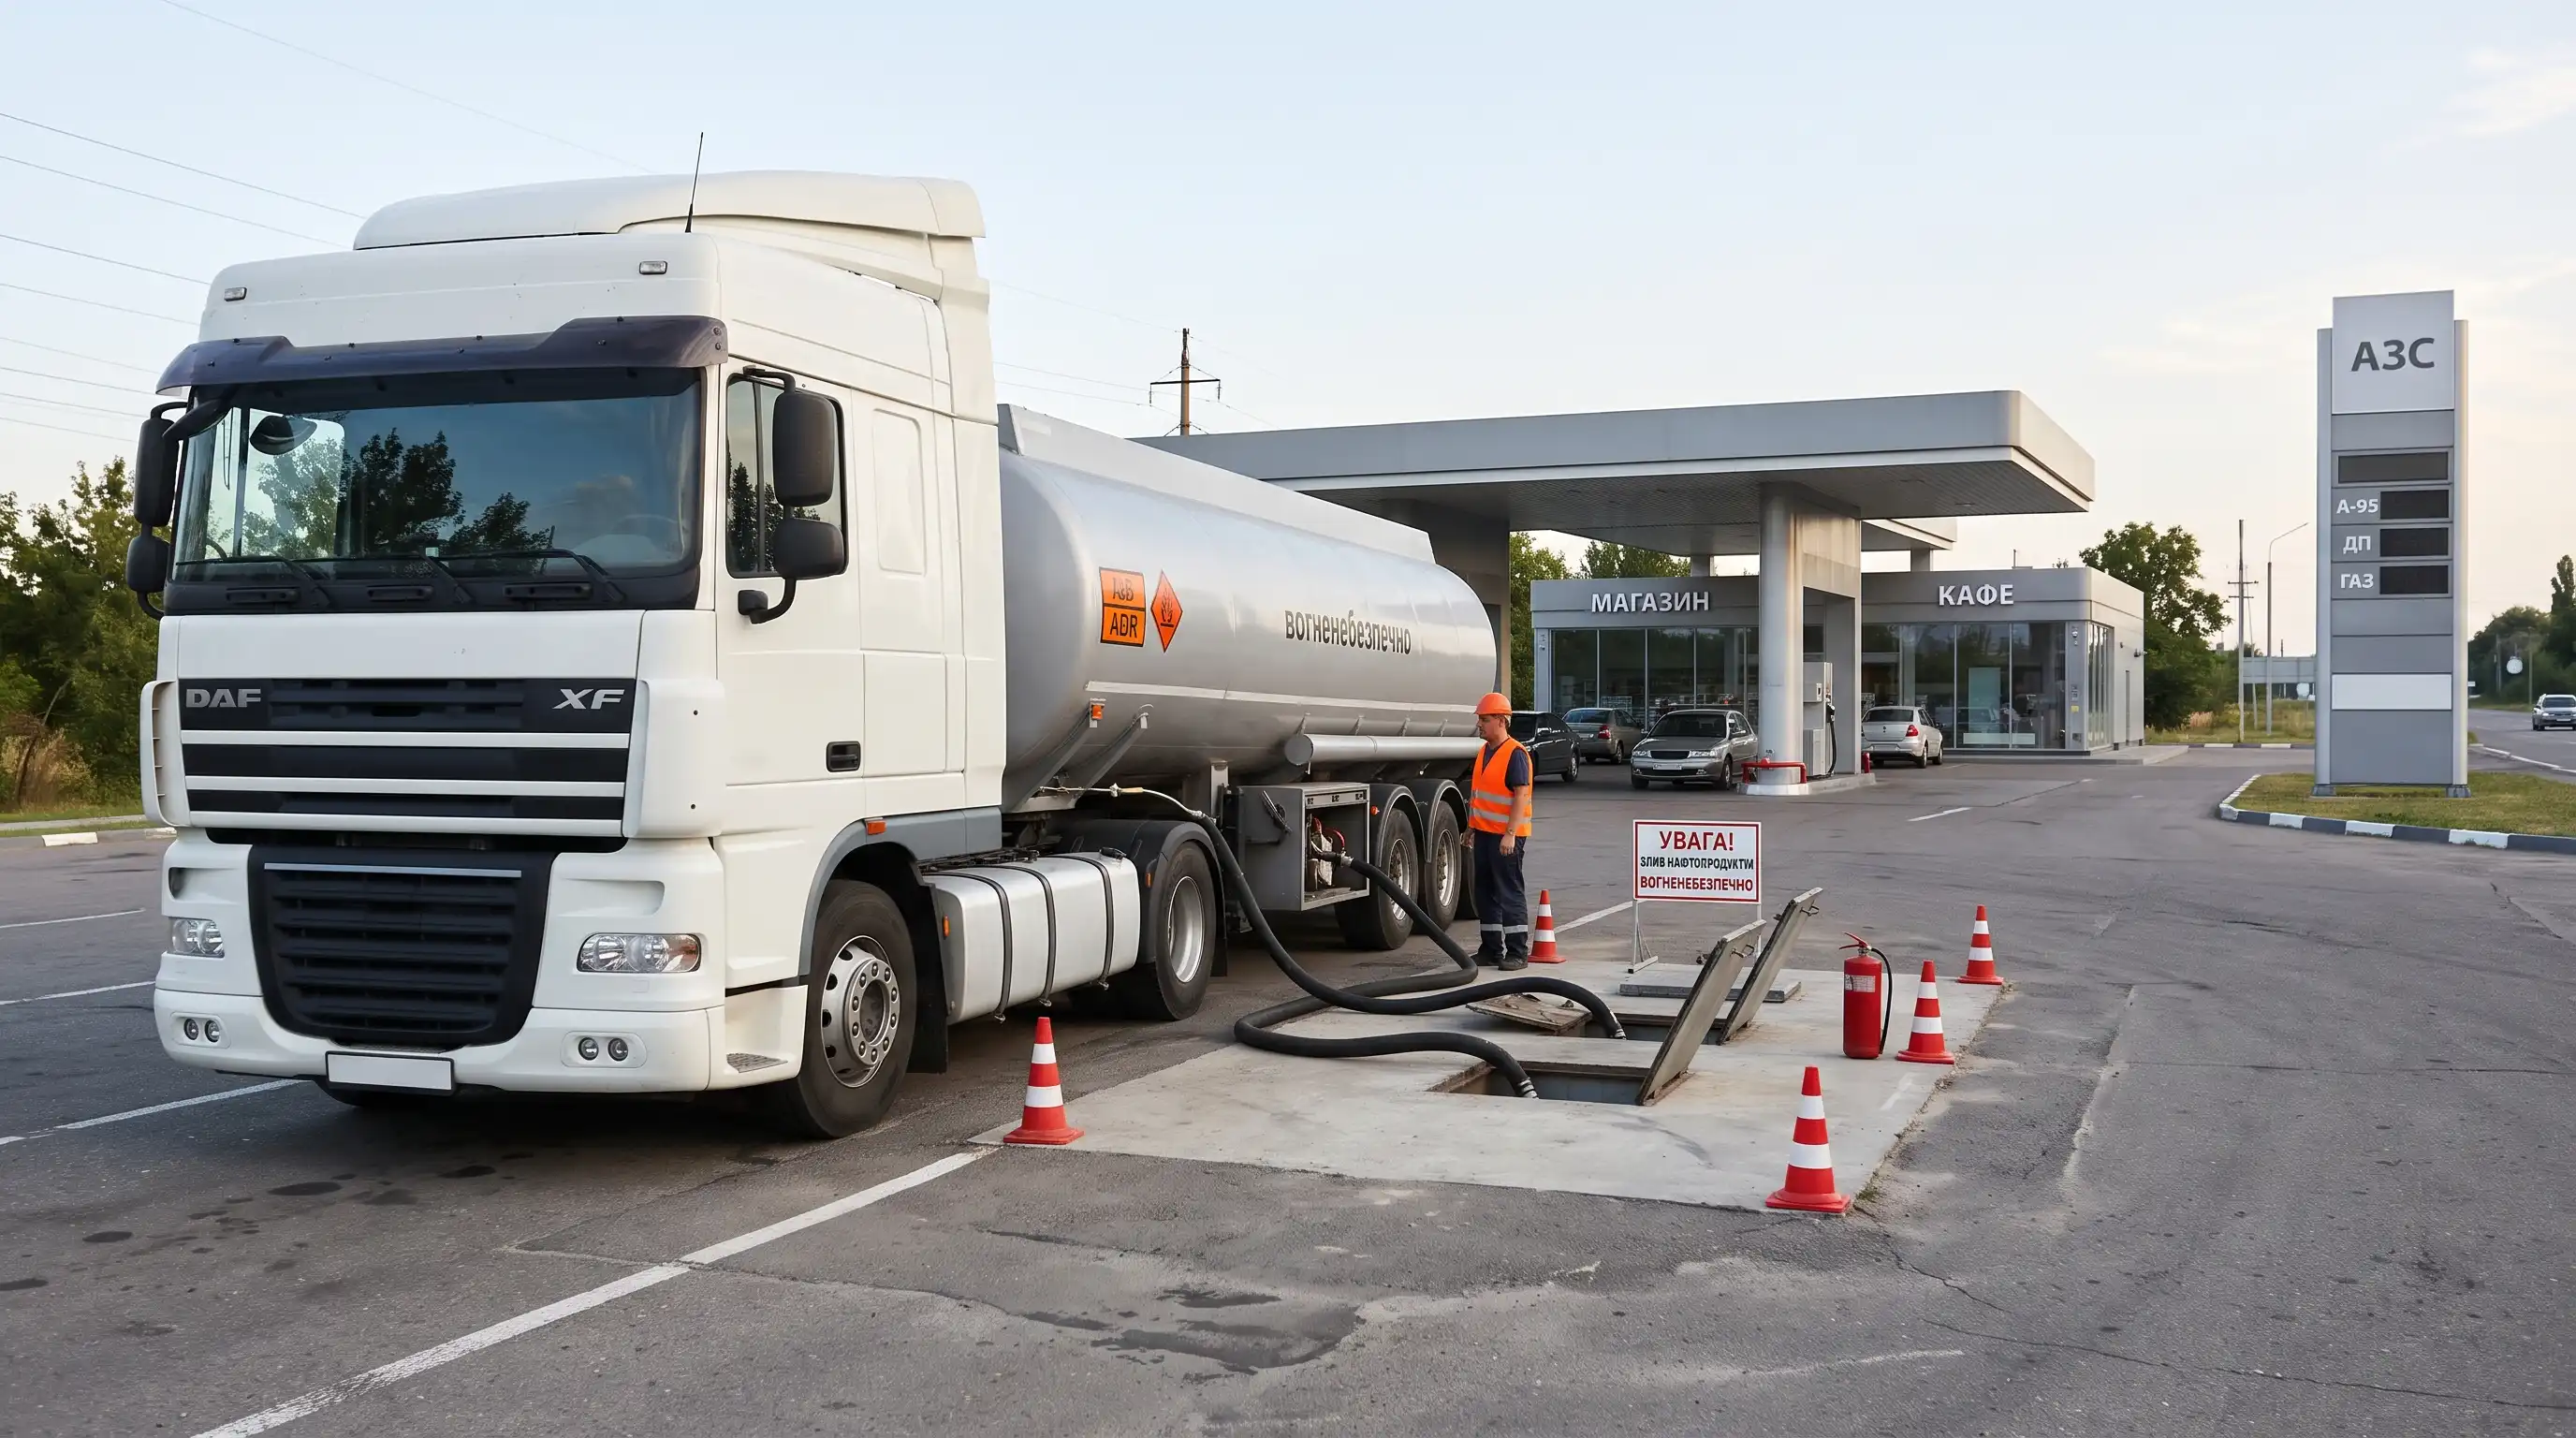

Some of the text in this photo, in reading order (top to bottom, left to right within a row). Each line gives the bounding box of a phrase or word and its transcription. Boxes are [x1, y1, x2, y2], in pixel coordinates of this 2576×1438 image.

[2350, 337, 2436, 372] АЗС
[2336, 498, 2378, 515] А-95
[2343, 536, 2371, 554] ДП
[2340, 573, 2374, 589] ГАЗ
[1591, 591, 1709, 612] МАГАЗИН
[1939, 583, 2014, 606] КАФЕ
[1110, 612, 1137, 638] ADR
[185, 688, 261, 708] DAF
[551, 688, 625, 710] XF
[1659, 830, 1734, 851] УВАГА!
[1640, 856, 1665, 867] ЗЛИВ
[1640, 875, 1753, 892] ВОГНЕНЕБЕЗПЕЧНО
